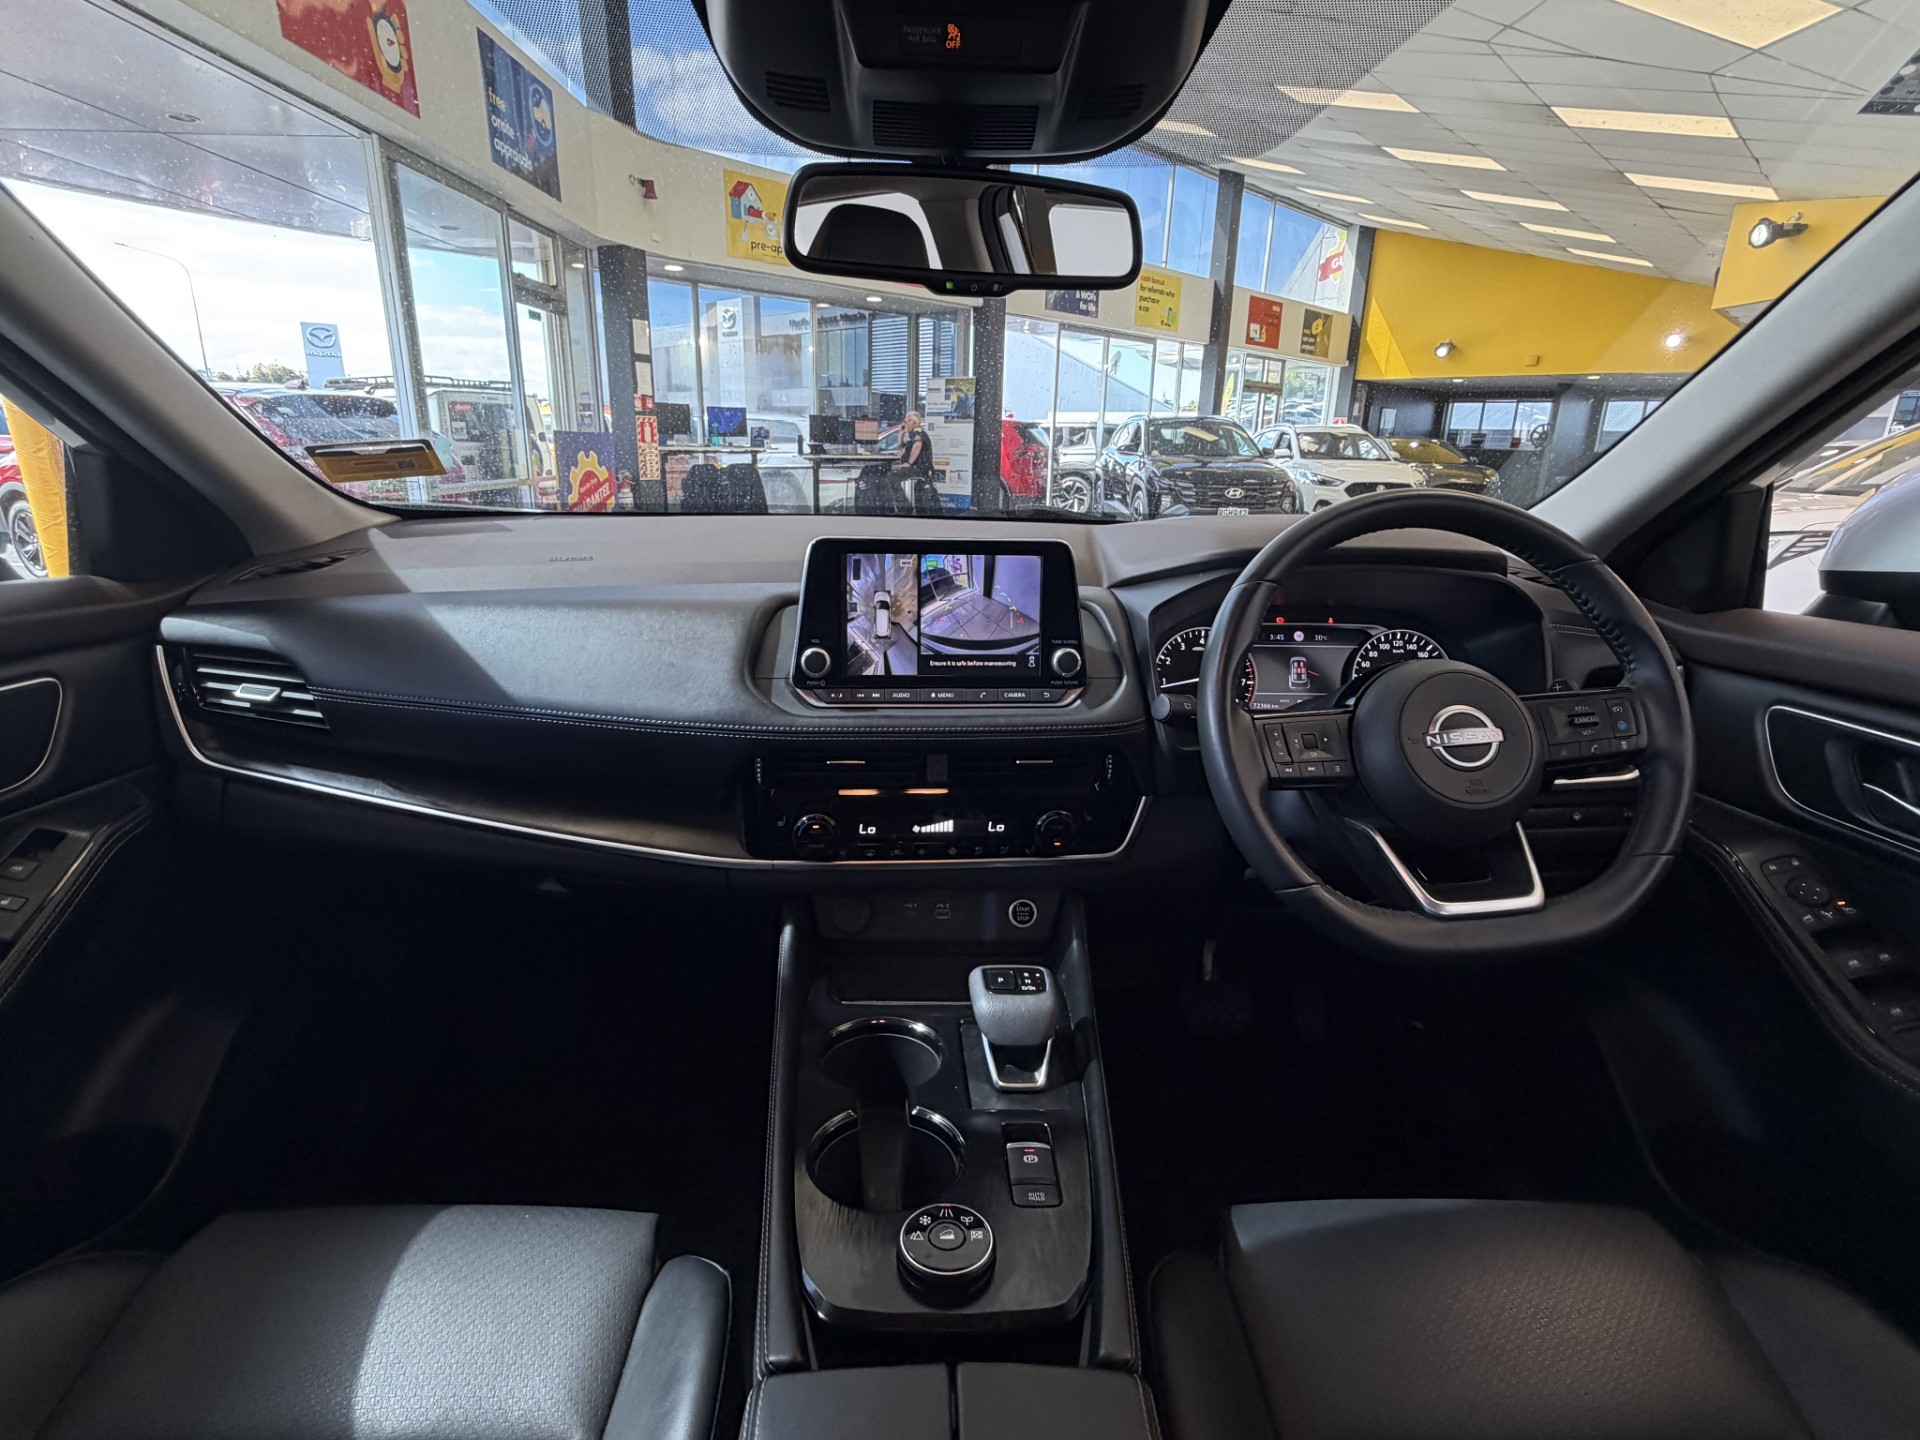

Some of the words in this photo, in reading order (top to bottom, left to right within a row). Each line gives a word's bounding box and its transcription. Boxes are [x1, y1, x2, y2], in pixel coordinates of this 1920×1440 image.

[946, 41, 961, 49] OFF
[488, 86, 505, 112] free
[491, 115, 515, 139] onsite
[494, 138, 533, 171] appraisals
[1088, 302, 1096, 312] life
[573, 483, 611, 512] UARANTEE
[1180, 642, 1186, 650] 3
[1166, 657, 1171, 665] 2
[1426, 729, 1503, 746] NISSAN
[859, 823, 876, 834] Lo
[988, 820, 1004, 832] Lo
